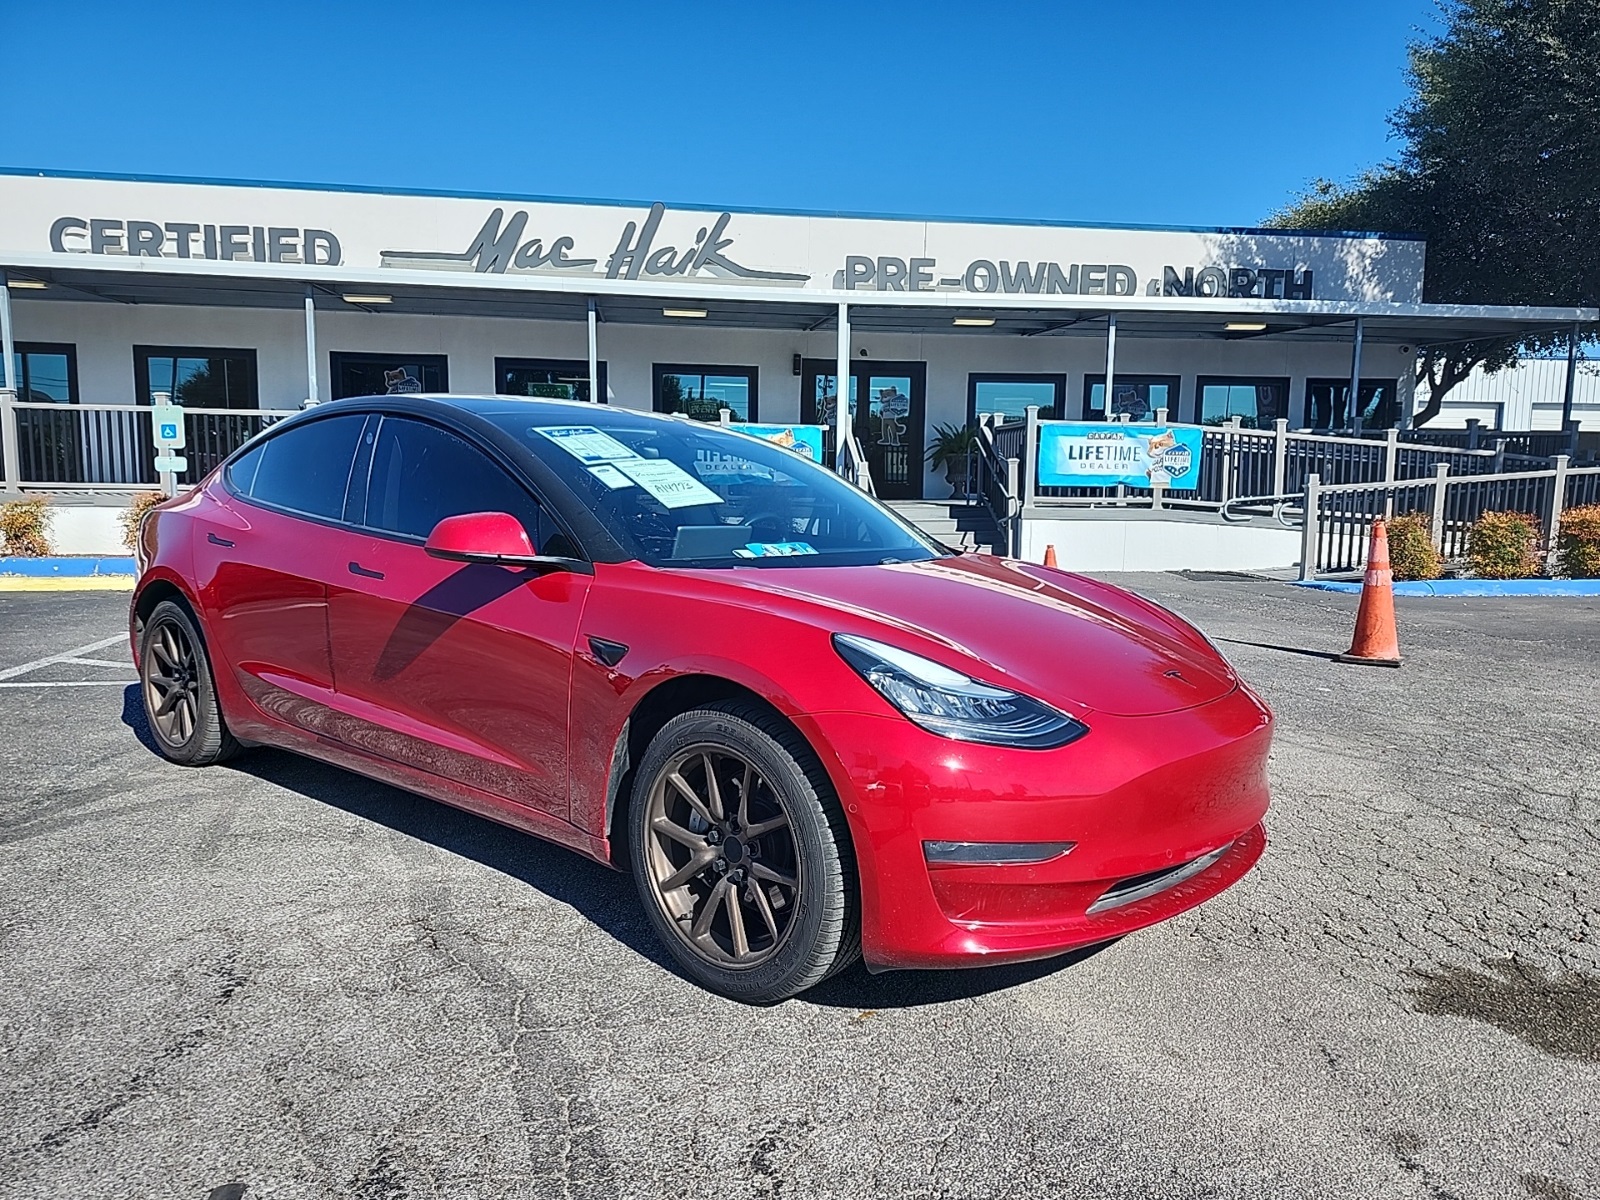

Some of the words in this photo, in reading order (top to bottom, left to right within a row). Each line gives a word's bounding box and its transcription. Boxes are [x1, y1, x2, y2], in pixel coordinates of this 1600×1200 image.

[49, 217, 344, 267] CERTIFIED
[379, 207, 598, 275] Mac
[604, 202, 811, 280] Haik
[844, 255, 1138, 297] PRE-OWNED
[1163, 264, 1315, 301] NORTH
[1068, 445, 1141, 461] LIFETIME
[1087, 432, 1125, 441] CARFAX
